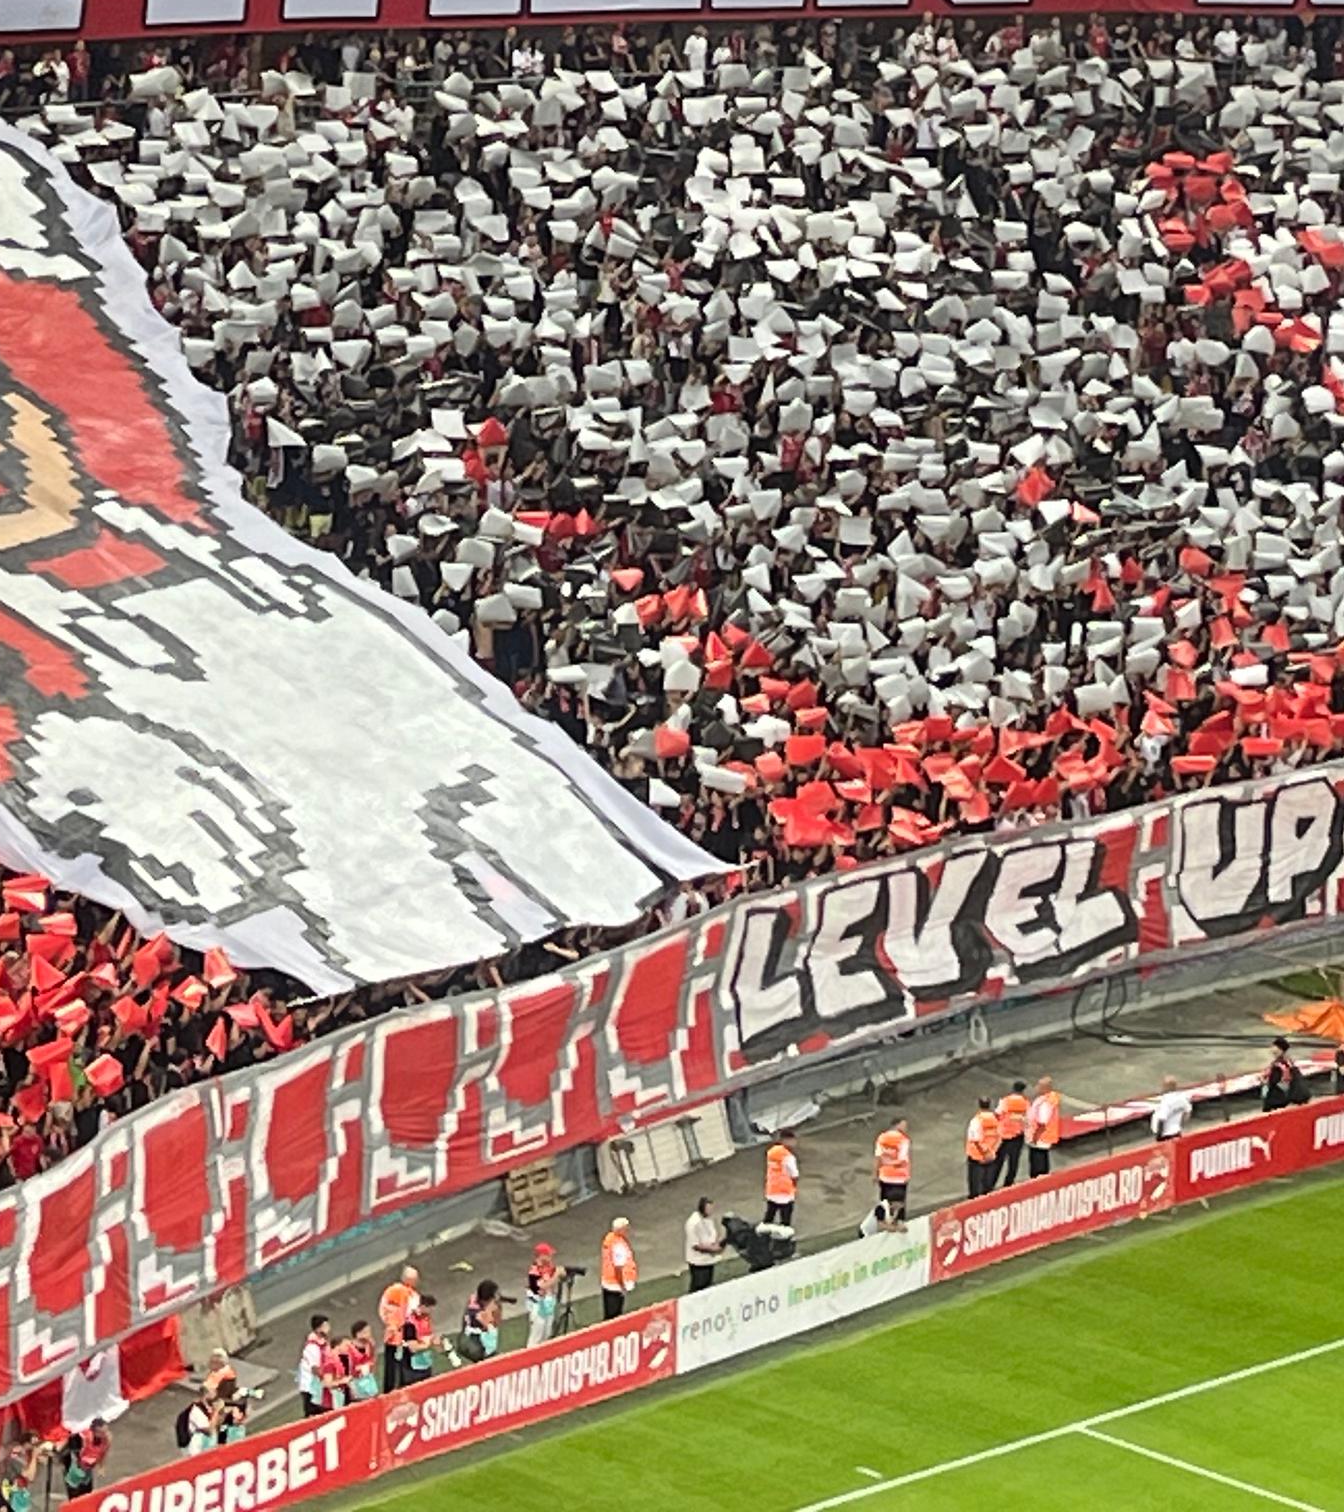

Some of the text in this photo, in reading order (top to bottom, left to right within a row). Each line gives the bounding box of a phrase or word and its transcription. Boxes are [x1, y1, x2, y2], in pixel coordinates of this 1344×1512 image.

[731, 838, 1129, 1044] LEVEL
[1179, 780, 1340, 922] UP
[1190, 1136, 1255, 1184] PUMA
